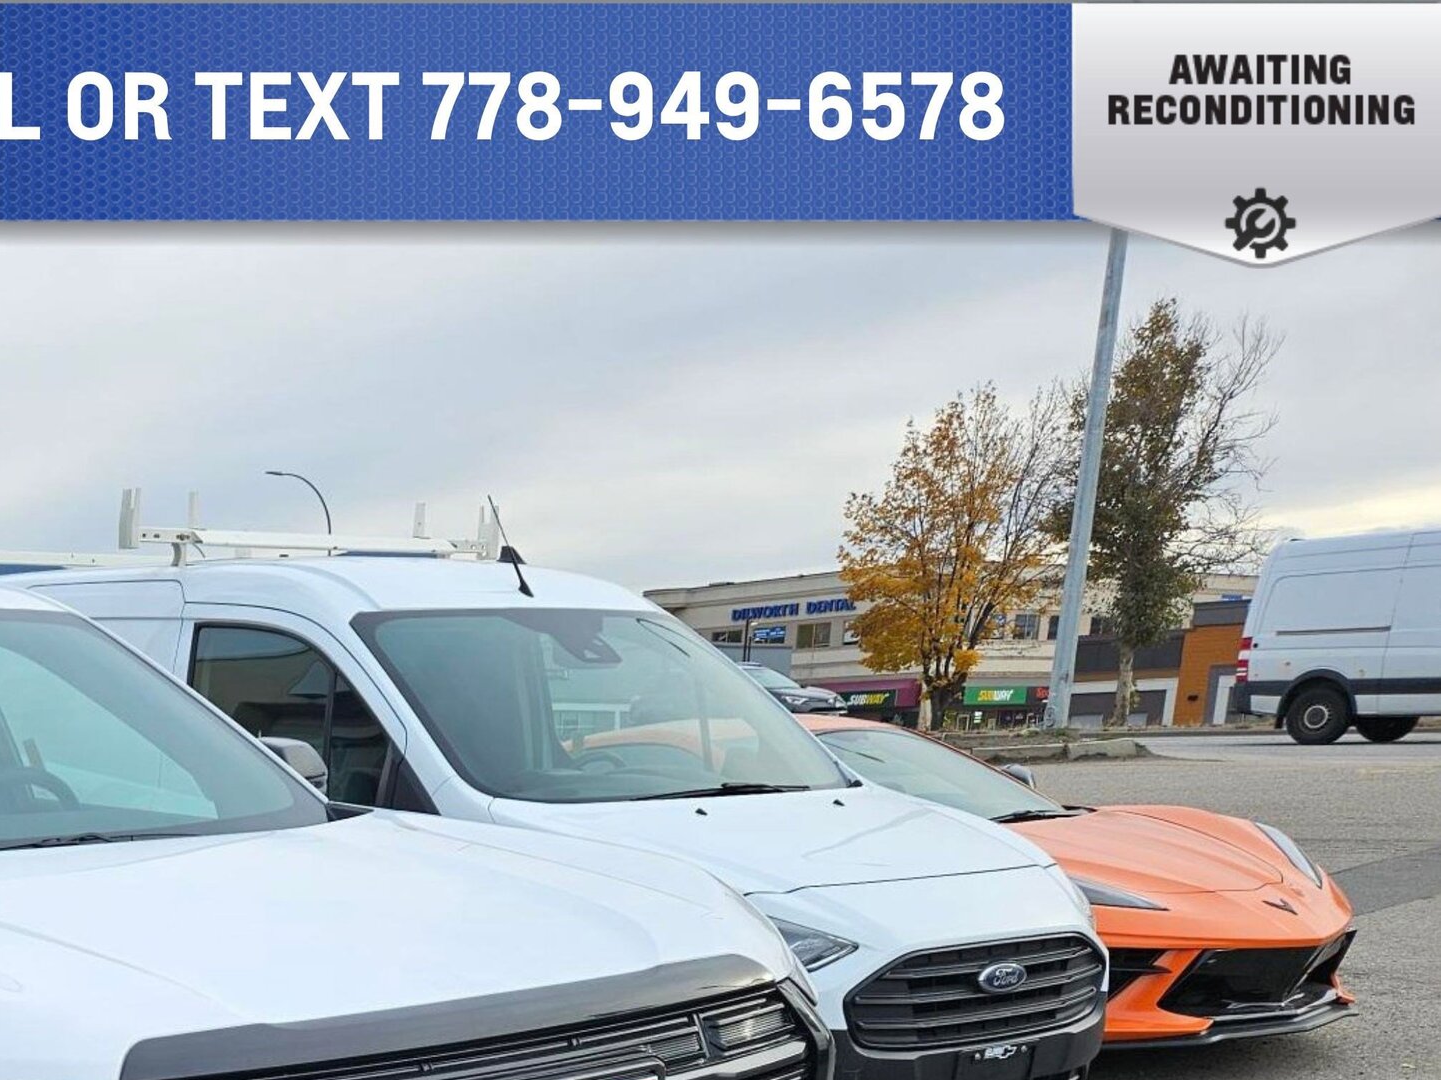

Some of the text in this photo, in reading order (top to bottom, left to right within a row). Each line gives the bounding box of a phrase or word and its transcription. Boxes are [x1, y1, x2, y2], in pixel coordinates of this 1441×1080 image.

[806, 598, 857, 615] DENTAL
[847, 692, 890, 705] SUBWAY
[977, 689, 1013, 702] SUBWAY
[992, 968, 1021, 986] Ford
